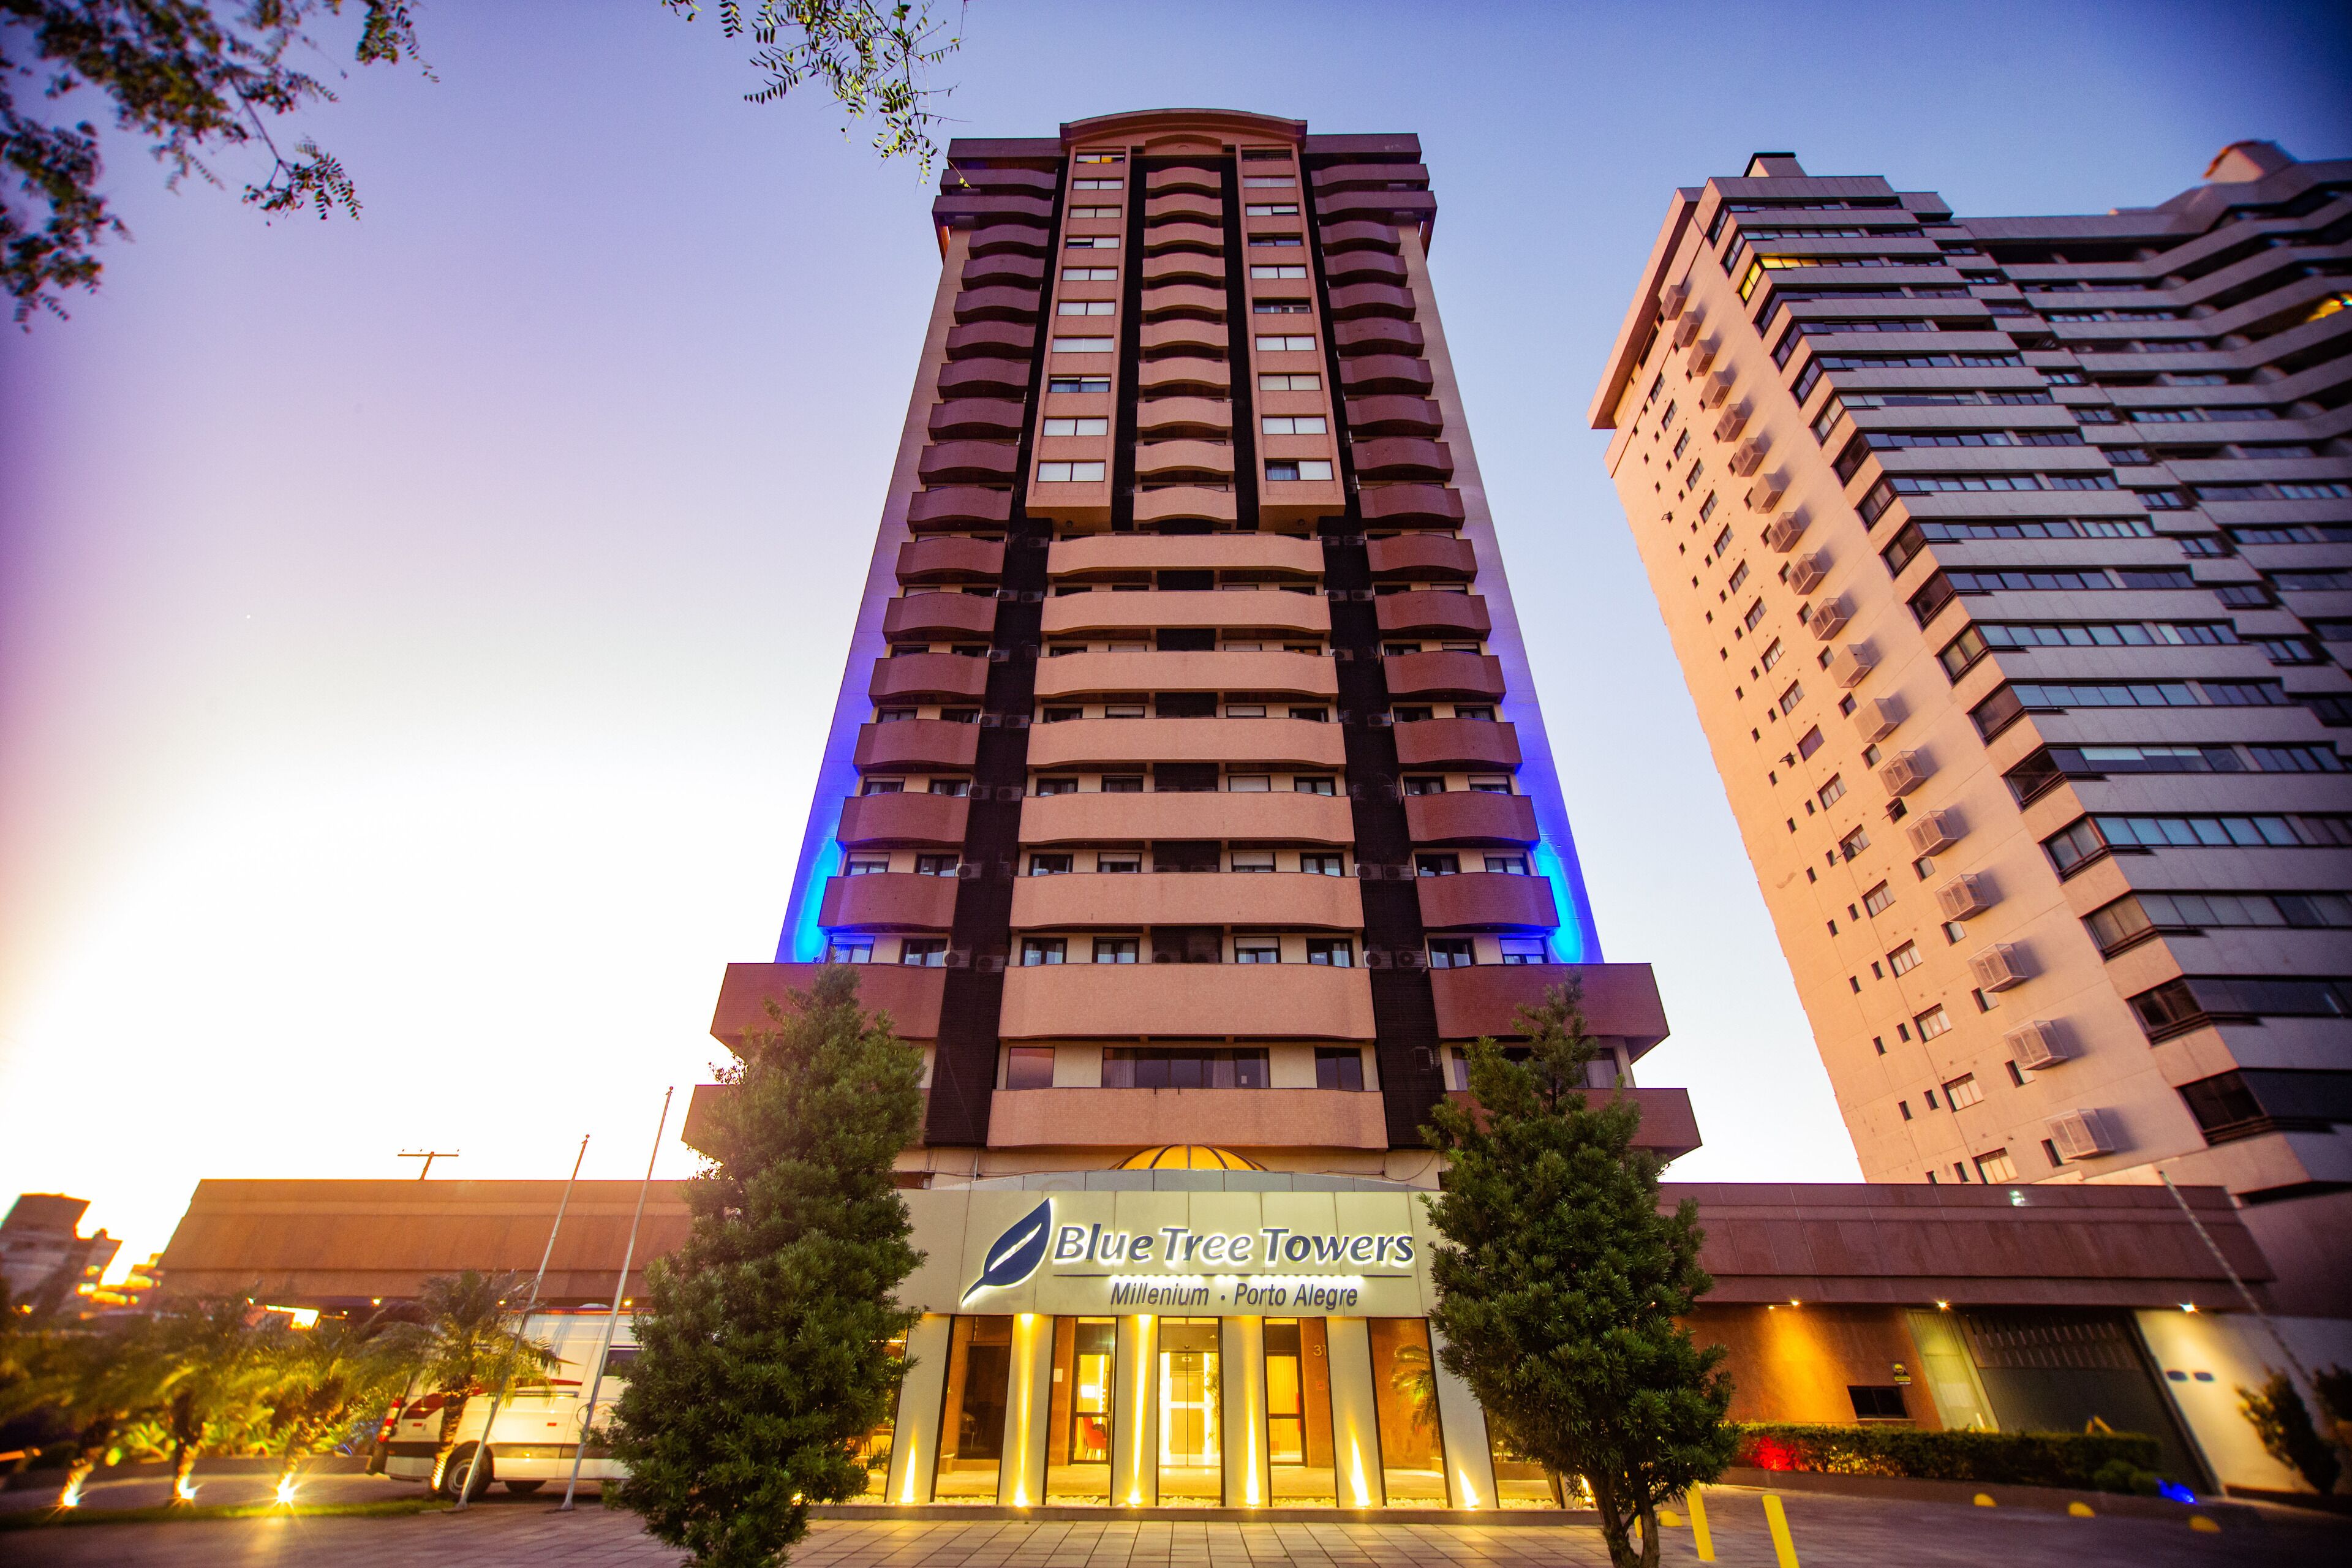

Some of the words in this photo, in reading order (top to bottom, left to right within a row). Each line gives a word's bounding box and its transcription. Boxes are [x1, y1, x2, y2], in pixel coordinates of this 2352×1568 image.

[1054, 1223, 1153, 1261] Blue
[1162, 1227, 1251, 1262] Tree
[1262, 1228, 1414, 1262] Towers
[1110, 1282, 1209, 1306] Millenium
[1234, 1283, 1286, 1306] Porto
[1293, 1283, 1358, 1311] Alegre
